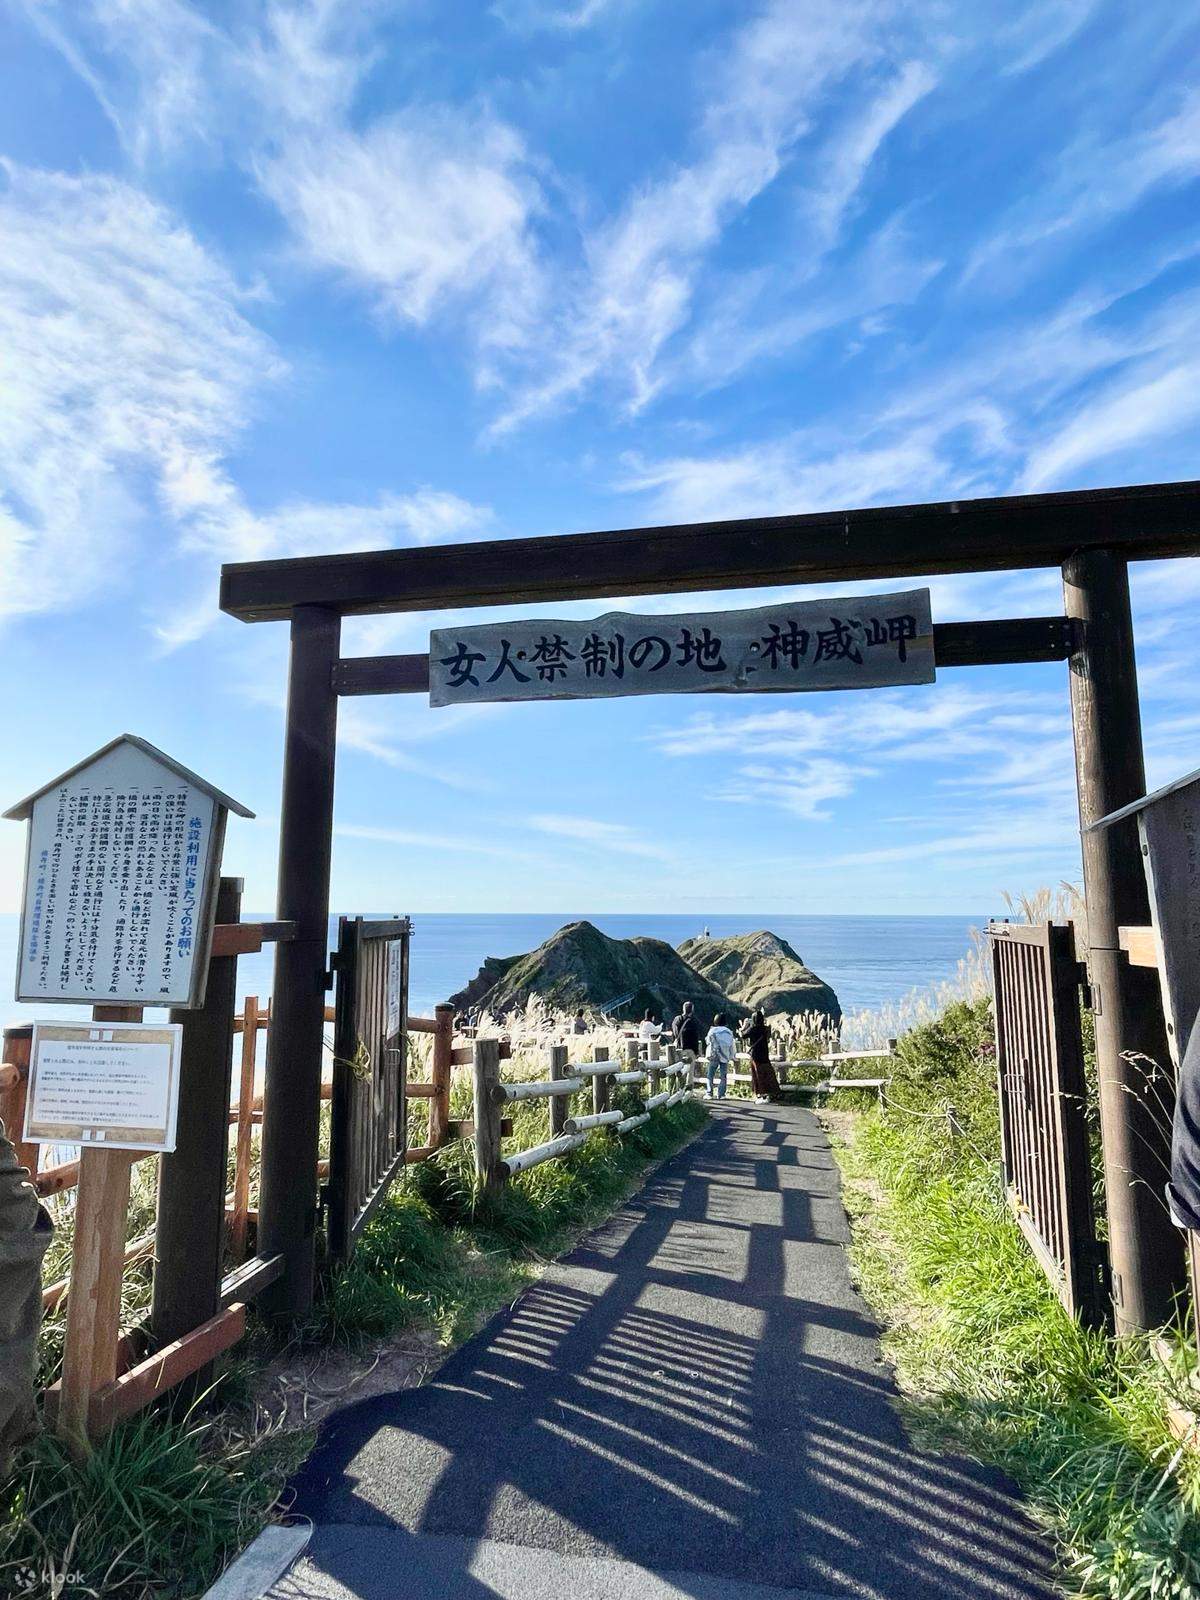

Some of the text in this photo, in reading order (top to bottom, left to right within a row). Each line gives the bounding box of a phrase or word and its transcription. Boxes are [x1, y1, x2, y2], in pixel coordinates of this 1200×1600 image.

[440, 614, 918, 688] 女人禁制の地 神威岬
[177, 816, 202, 958] 施設利用に当たってのお願い
